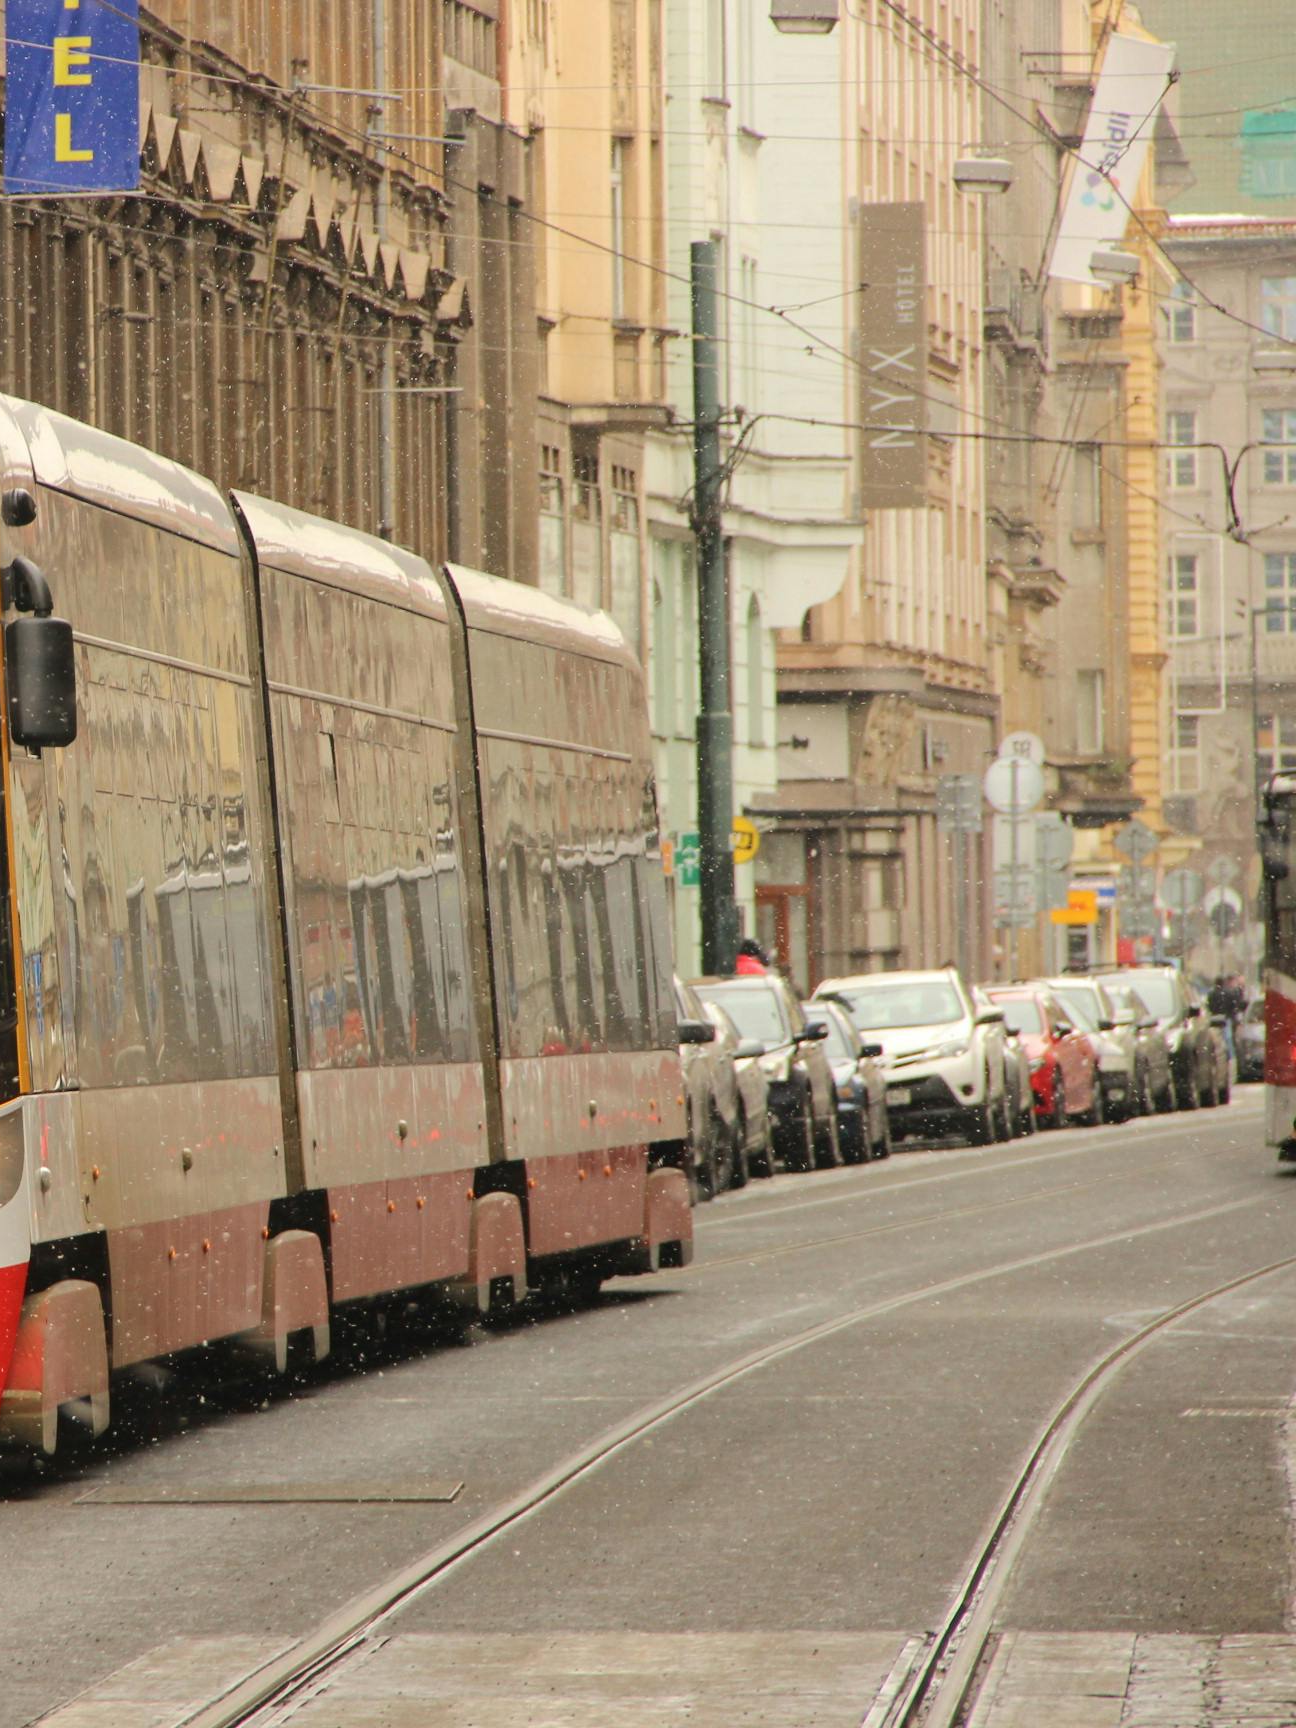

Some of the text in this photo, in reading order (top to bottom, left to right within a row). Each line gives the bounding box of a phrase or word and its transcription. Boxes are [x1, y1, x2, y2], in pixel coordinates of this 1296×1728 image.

[53, 0, 93, 162] EL
[870, 264, 915, 448] NYX HOTEL
